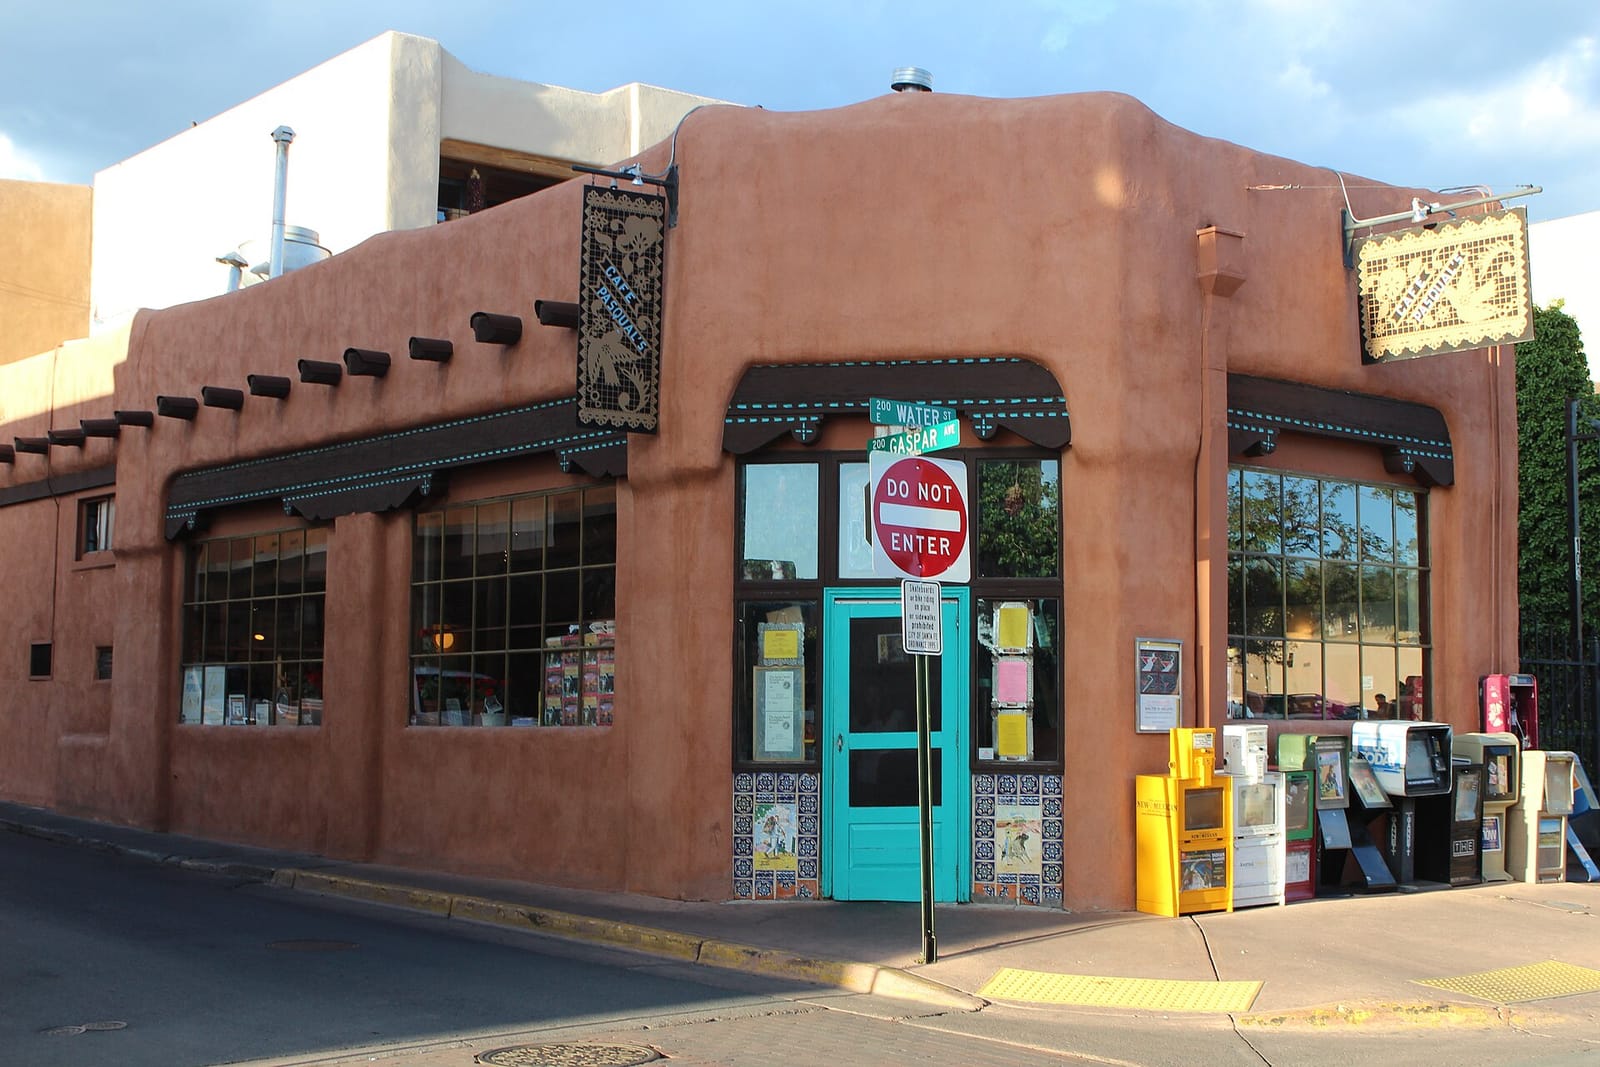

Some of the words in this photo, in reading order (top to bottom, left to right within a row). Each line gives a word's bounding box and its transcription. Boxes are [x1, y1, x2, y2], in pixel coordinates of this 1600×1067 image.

[606, 266, 636, 304] CAFE
[1397, 276, 1426, 316] CAFE
[596, 286, 647, 353] PASQUAL'S
[876, 399, 891, 411] 200
[896, 404, 940, 427] WATER
[943, 411, 951, 421] ST
[876, 412, 881, 422] E
[872, 438, 885, 450] 200
[889, 428, 937, 454] GASPAR
[943, 423, 955, 437] AVE
[887, 478, 909, 498] DO
[918, 482, 952, 504] NOT
[891, 532, 950, 556] ENTER
[1454, 841, 1474, 853] THE
